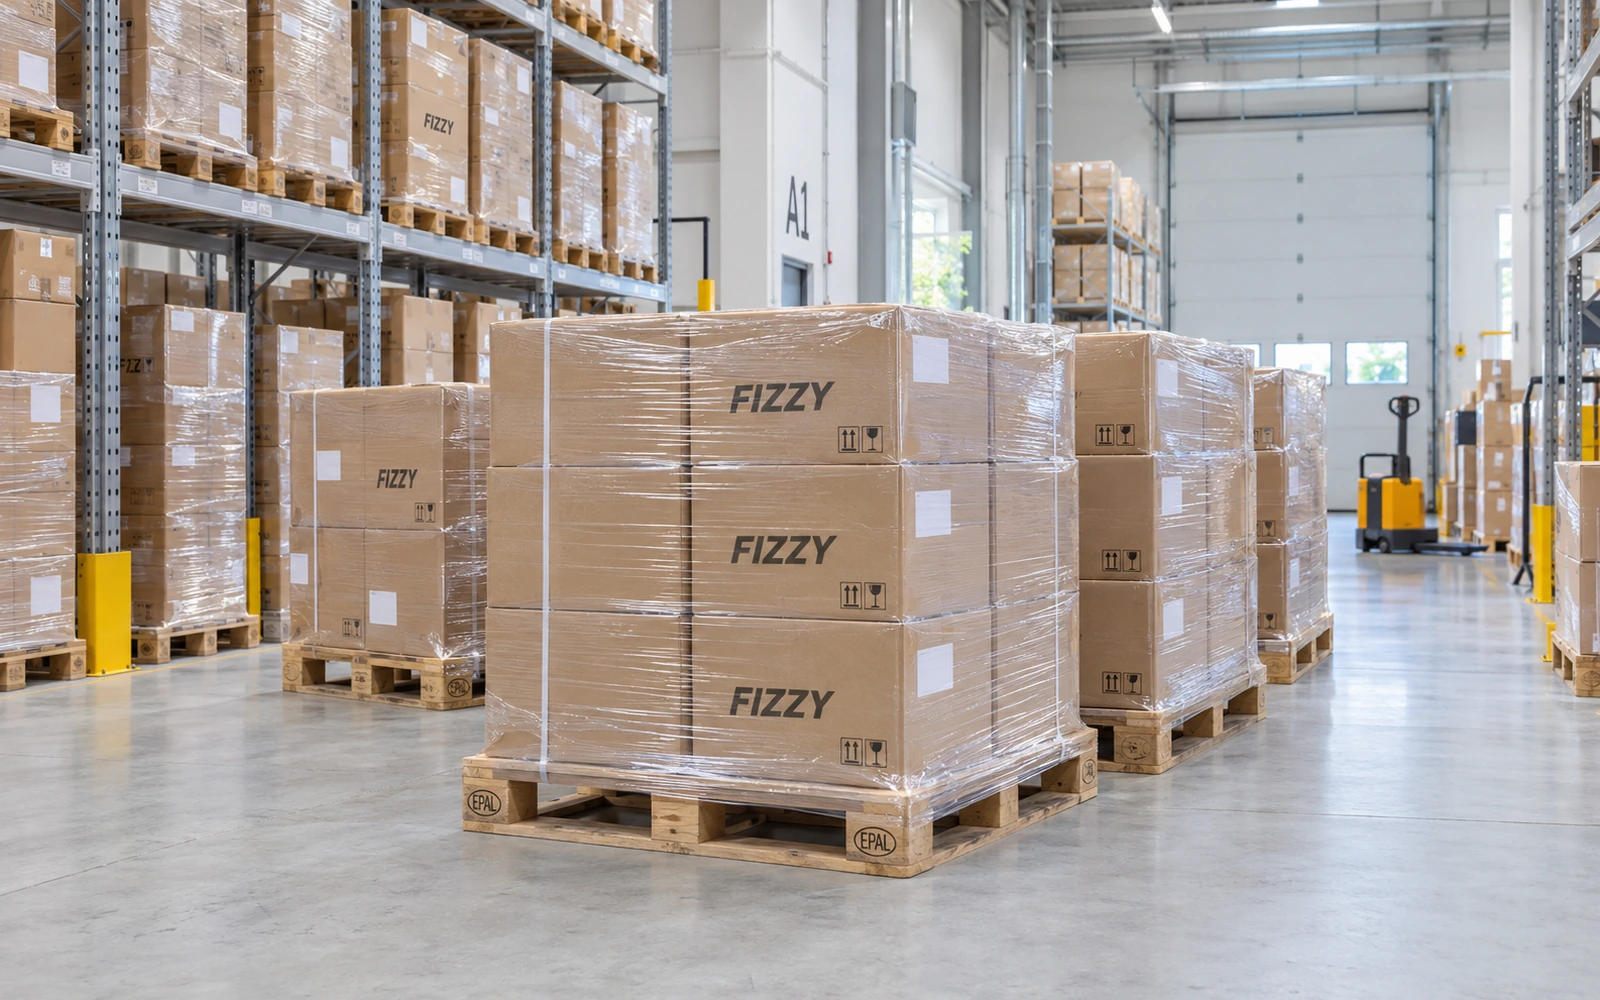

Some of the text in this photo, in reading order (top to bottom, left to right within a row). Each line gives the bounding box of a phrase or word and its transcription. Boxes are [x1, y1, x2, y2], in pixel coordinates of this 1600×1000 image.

[424, 113, 454, 135] FIZZY
[786, 175, 809, 241] A1
[729, 381, 835, 414] FIZZY
[376, 469, 418, 489] FIZZY
[730, 535, 838, 565] FIZZY
[729, 686, 836, 720] FIZZY
[472, 794, 497, 812] EPAL
[860, 831, 891, 852] EPAL
